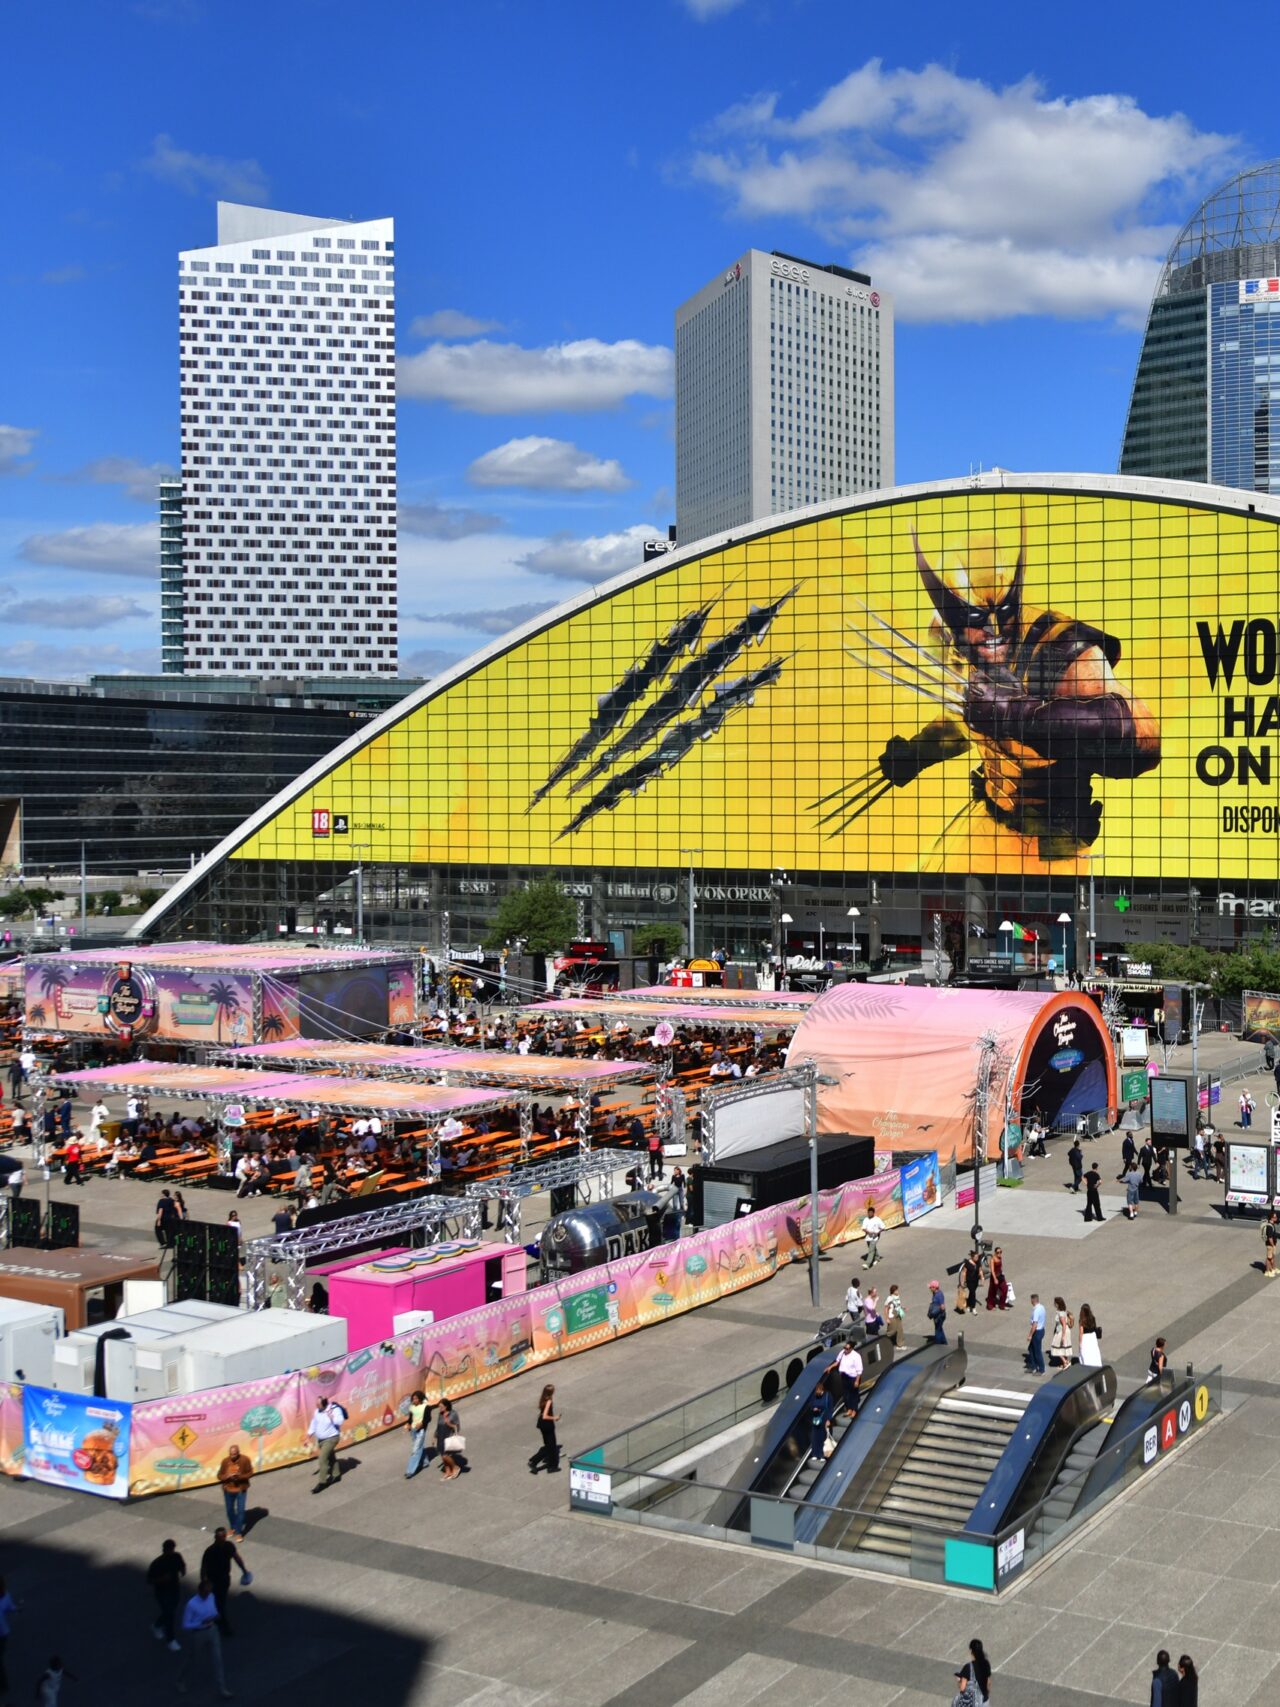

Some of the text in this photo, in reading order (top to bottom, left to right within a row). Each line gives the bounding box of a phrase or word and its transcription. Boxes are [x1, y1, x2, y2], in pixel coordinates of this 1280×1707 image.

[1195, 745, 1271, 786] ON
[313, 812, 329, 829] 18
[607, 883, 650, 898] Hilton
